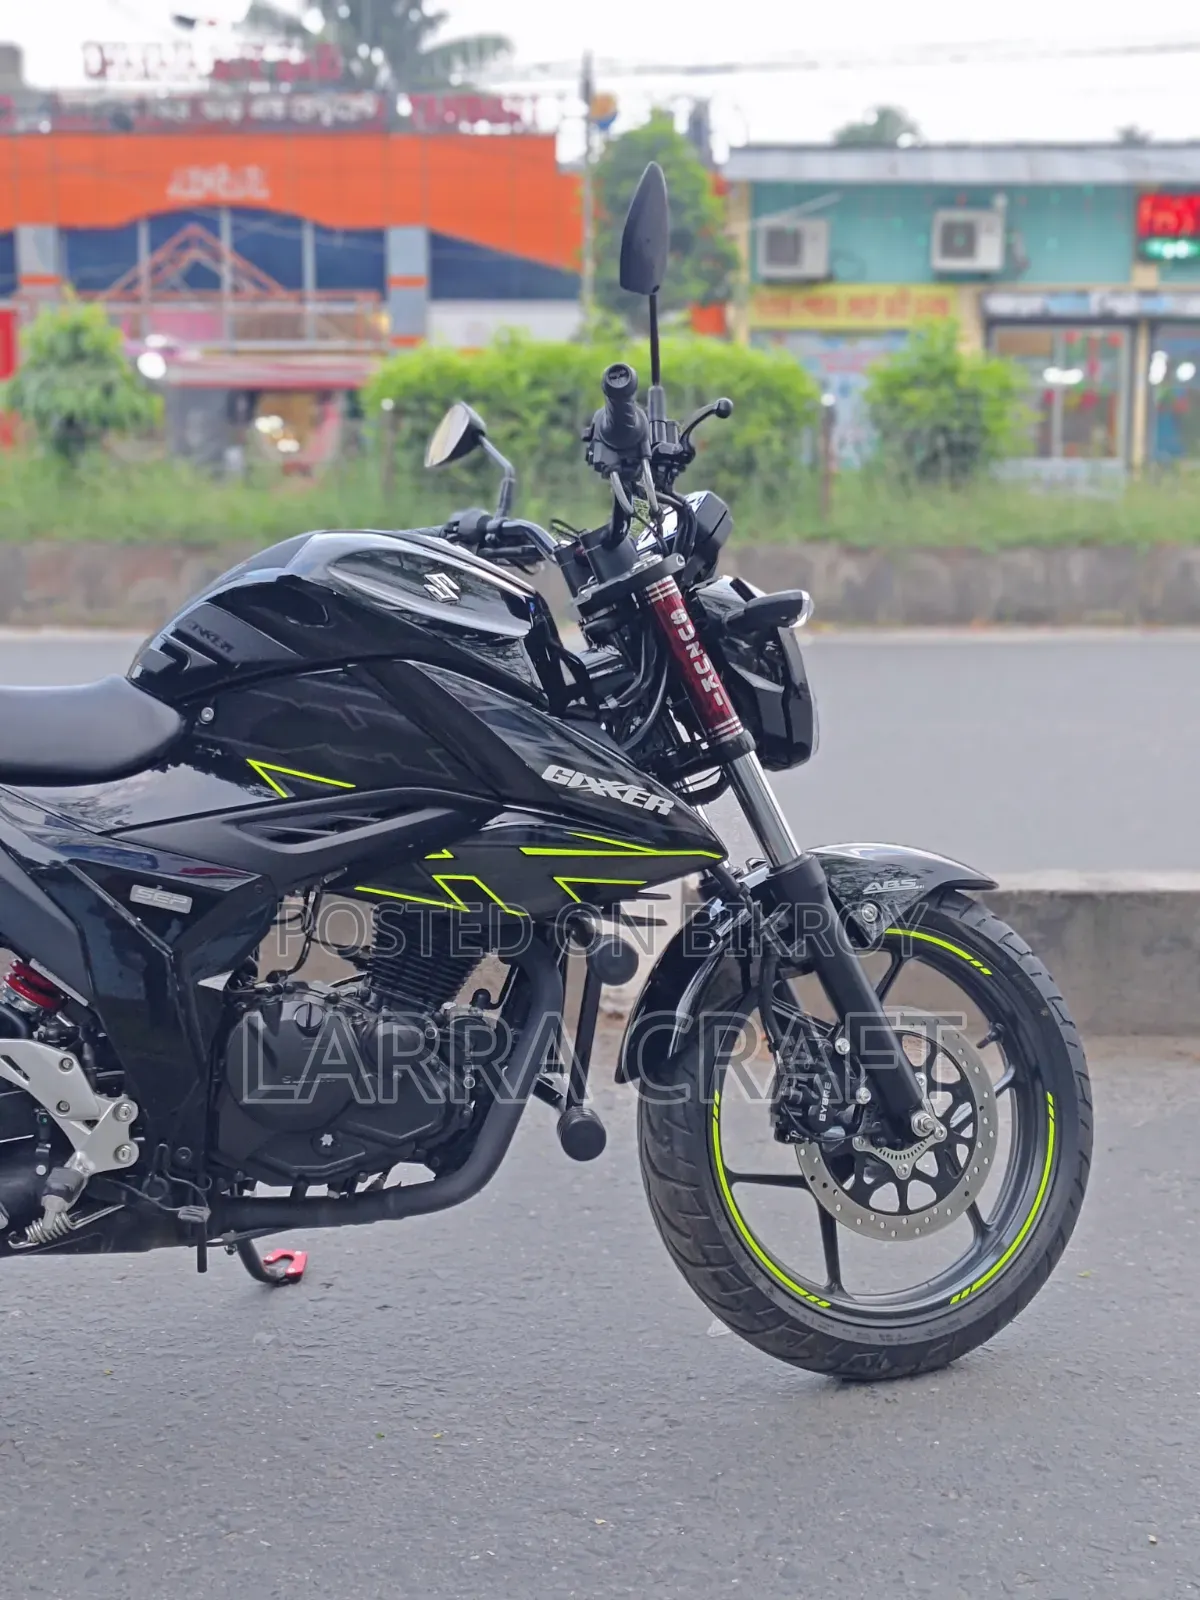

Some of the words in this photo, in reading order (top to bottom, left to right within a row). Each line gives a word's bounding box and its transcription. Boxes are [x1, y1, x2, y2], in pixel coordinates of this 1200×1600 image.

[670, 608, 724, 707] SUZUKI
[541, 764, 675, 816] GIXXER
[134, 888, 188, 905] SEP
[862, 878, 918, 894] ABS
[818, 1081, 832, 1122] BYBRE
